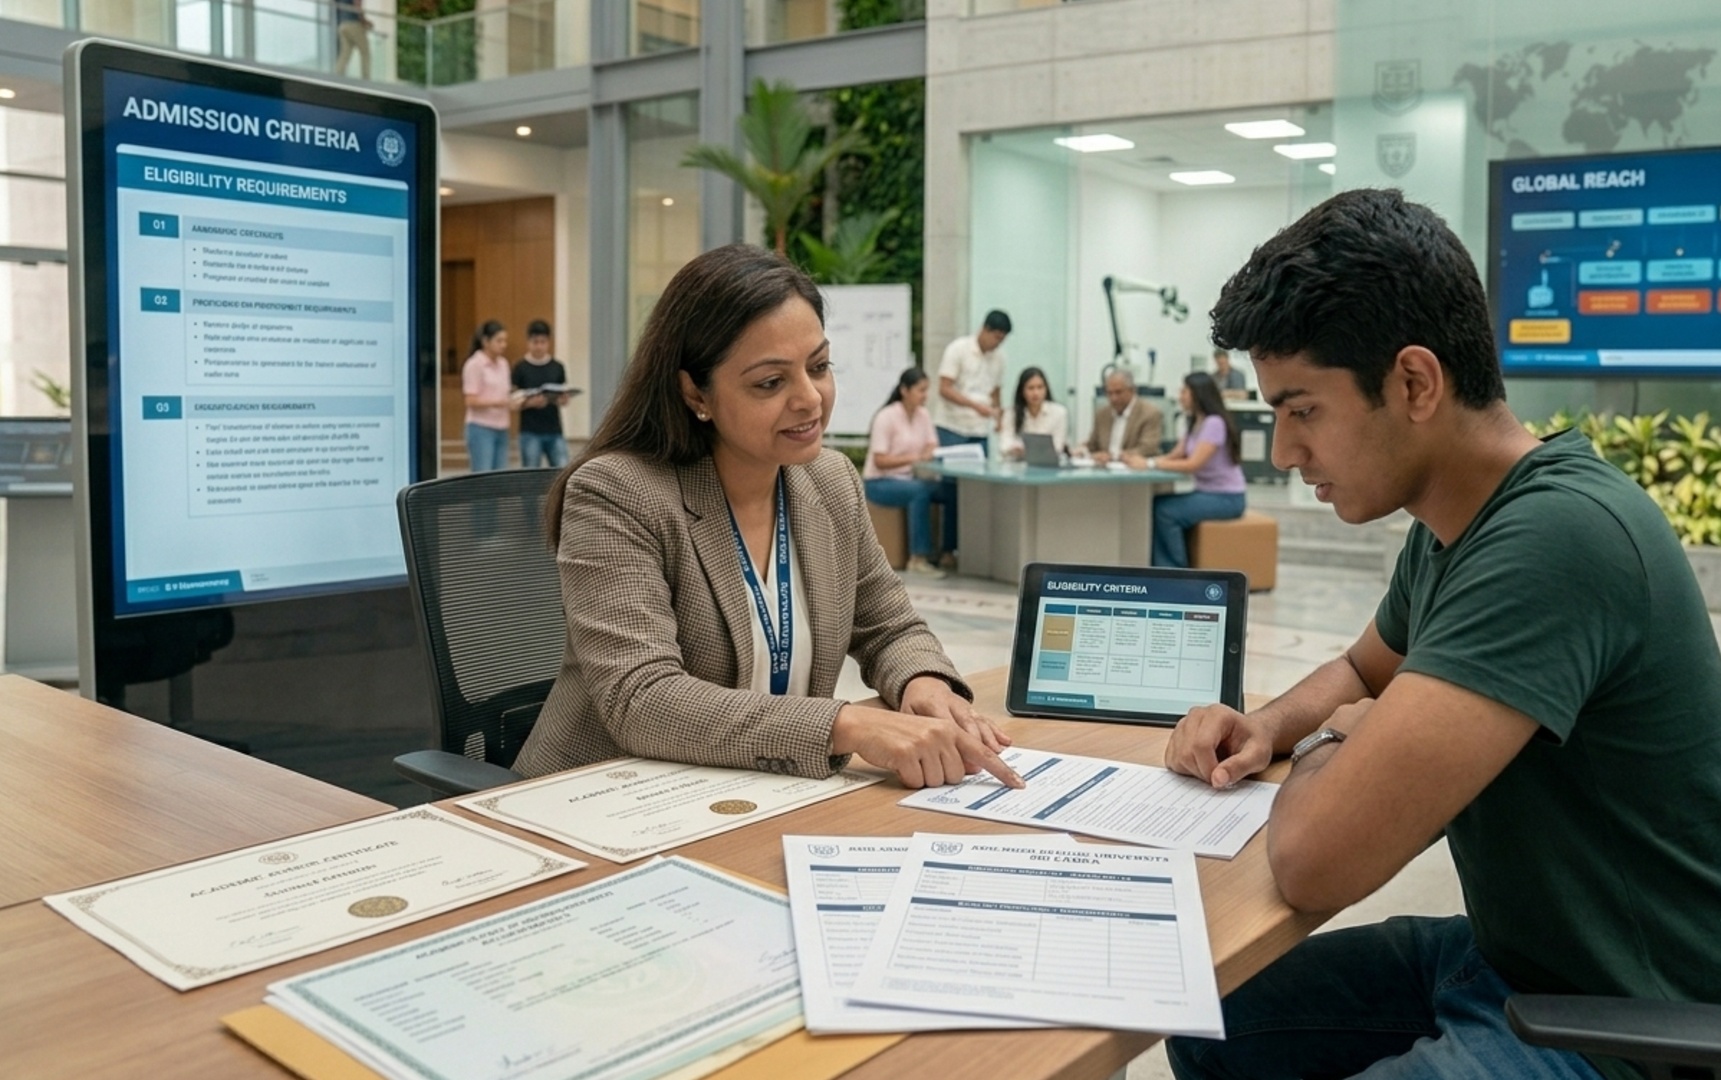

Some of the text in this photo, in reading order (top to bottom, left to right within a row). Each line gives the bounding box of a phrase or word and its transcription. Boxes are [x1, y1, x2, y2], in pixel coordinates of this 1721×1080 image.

[122, 96, 361, 153] ADMISSION CRITERIA
[144, 165, 347, 204] ELIGIBILITY REQUIREMENTS
[1511, 169, 1646, 193] GLOBAL REACH
[153, 219, 166, 231] 01
[1103, 583, 1148, 595] CRITERIA
